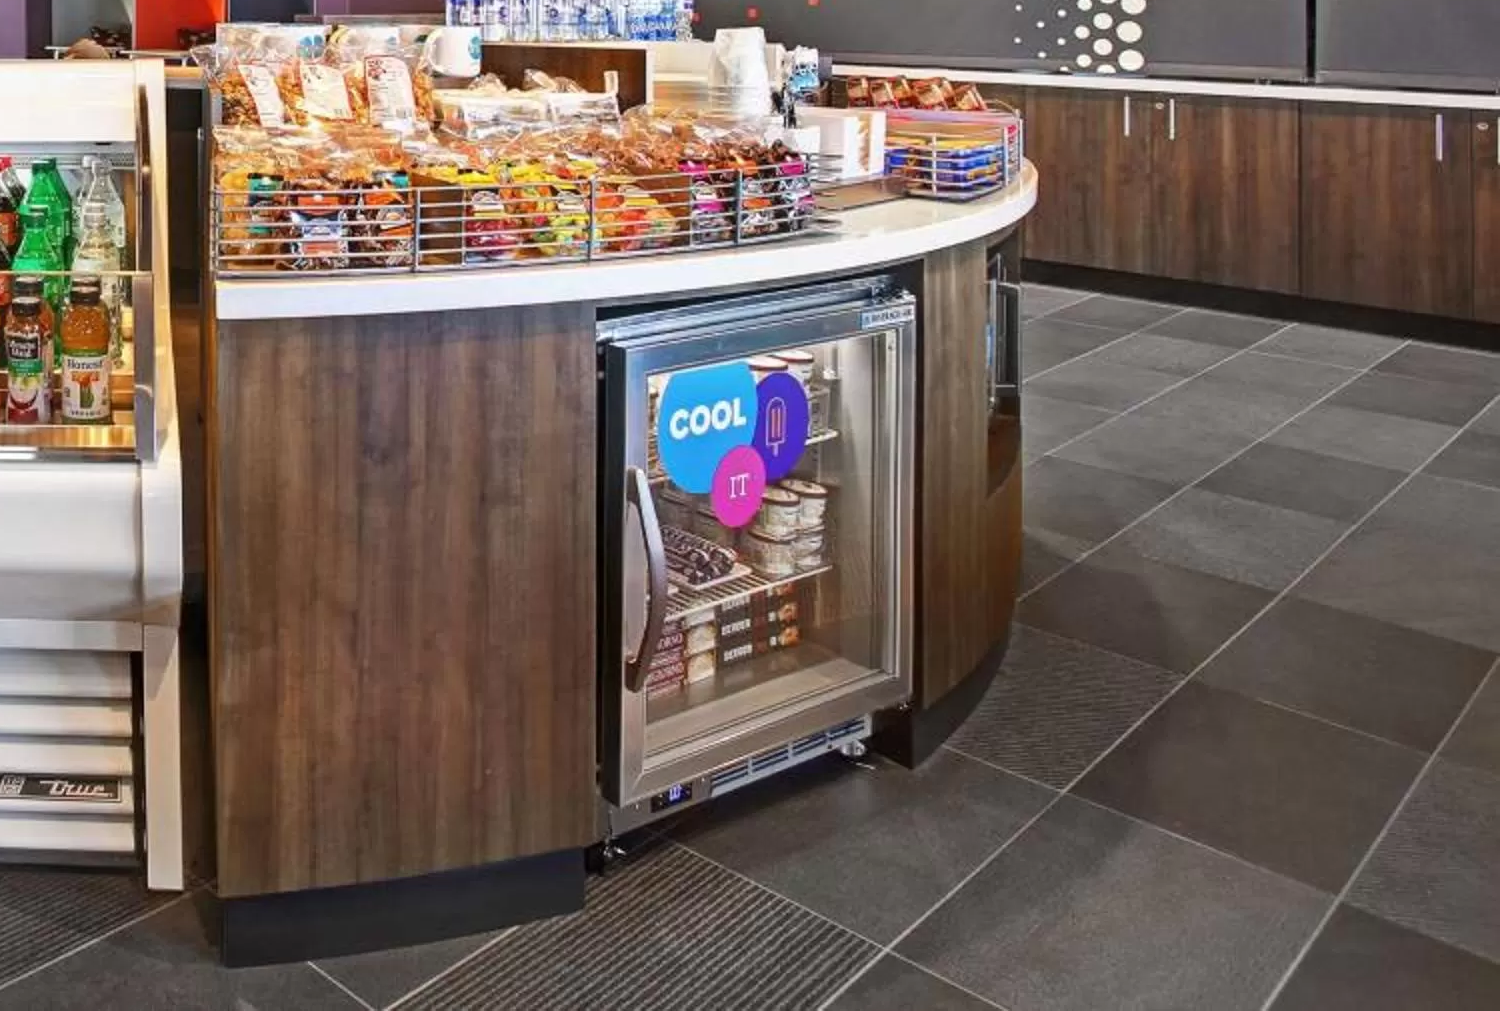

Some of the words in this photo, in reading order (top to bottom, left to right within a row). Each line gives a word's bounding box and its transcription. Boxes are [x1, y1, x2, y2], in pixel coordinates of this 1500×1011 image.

[669, 397, 747, 440] COOL
[729, 473, 750, 499] IT
[39, 779, 113, 797] True
